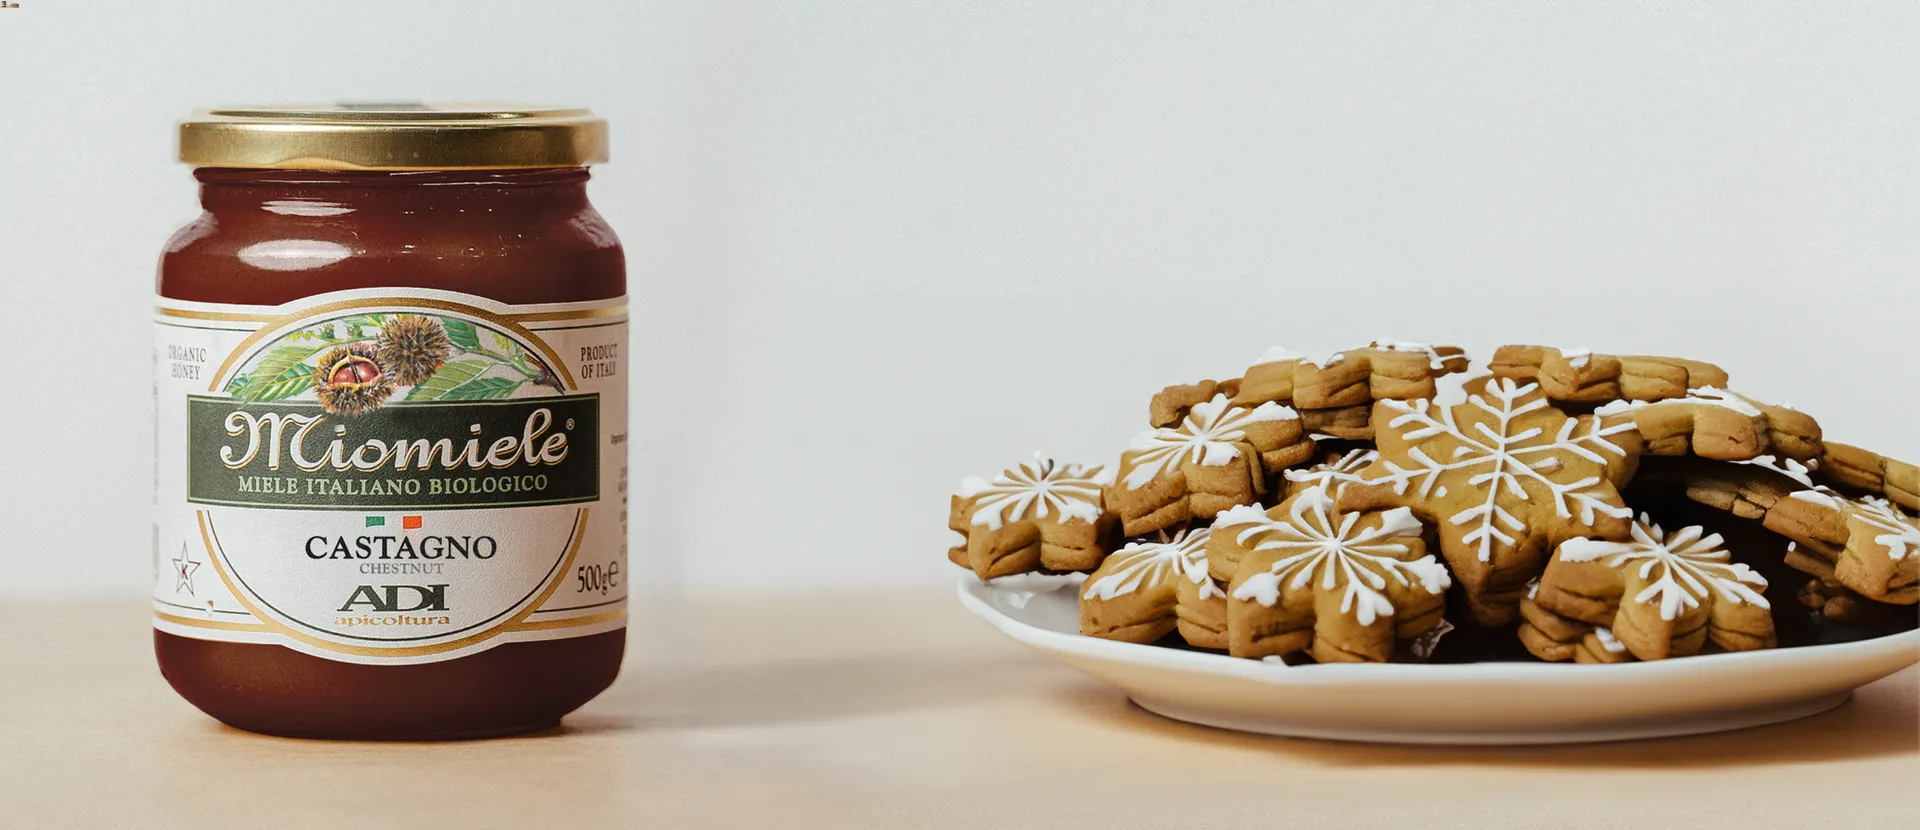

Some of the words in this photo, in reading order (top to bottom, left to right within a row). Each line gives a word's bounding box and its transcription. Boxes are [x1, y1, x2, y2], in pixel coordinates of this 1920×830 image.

[580, 343, 617, 361] PRODUCT
[171, 363, 200, 380] HONEY
[581, 364, 593, 379] OF
[238, 474, 299, 493] MIELE
[305, 477, 422, 496] ITALIANO
[428, 474, 548, 495] BIOLOGICO
[304, 535, 497, 560] CASTAGNO
[359, 562, 444, 575] CHESTNUT
[337, 584, 450, 612] ADI
[334, 613, 450, 627] apicoltura
